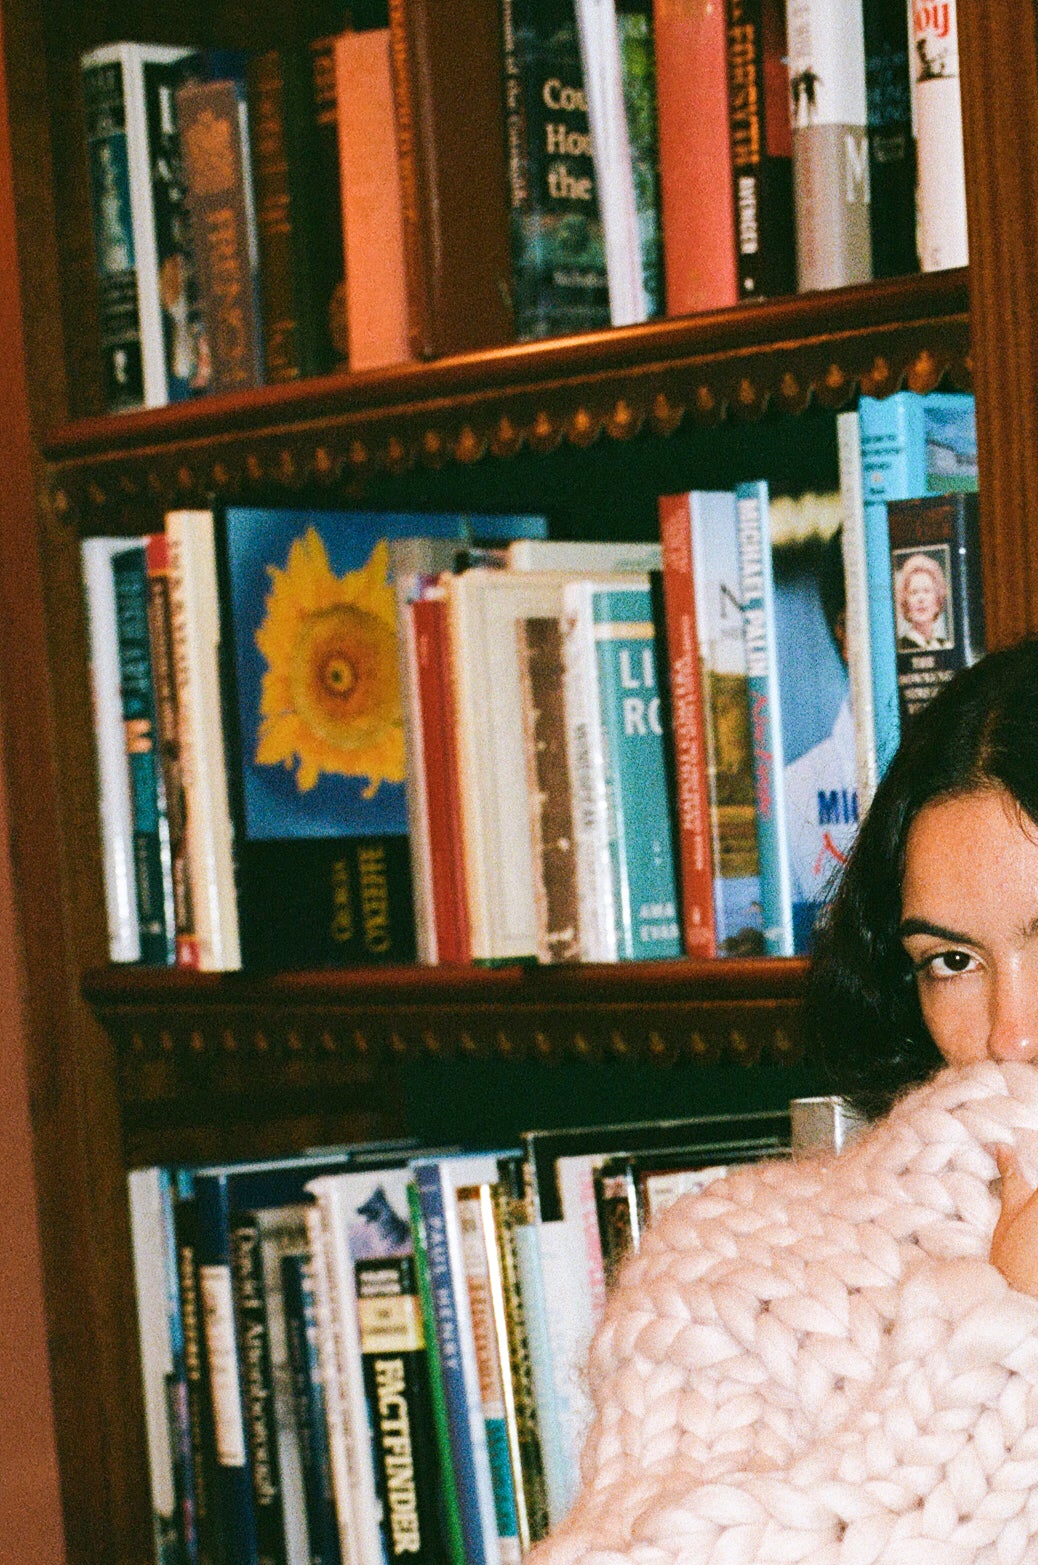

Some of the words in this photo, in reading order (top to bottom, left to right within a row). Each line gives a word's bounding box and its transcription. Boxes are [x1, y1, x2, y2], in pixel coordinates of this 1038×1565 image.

[730, 23, 760, 167] FORSYTH
[547, 164, 593, 200] the
[738, 176, 758, 255] AVENGER
[737, 498, 763, 600] MICHAEL
[745, 608, 768, 678] PALIN
[428, 1215, 448, 1277] PAUL
[439, 1287, 459, 1371] HENRY
[373, 1357, 422, 1556] FACTFINDER
